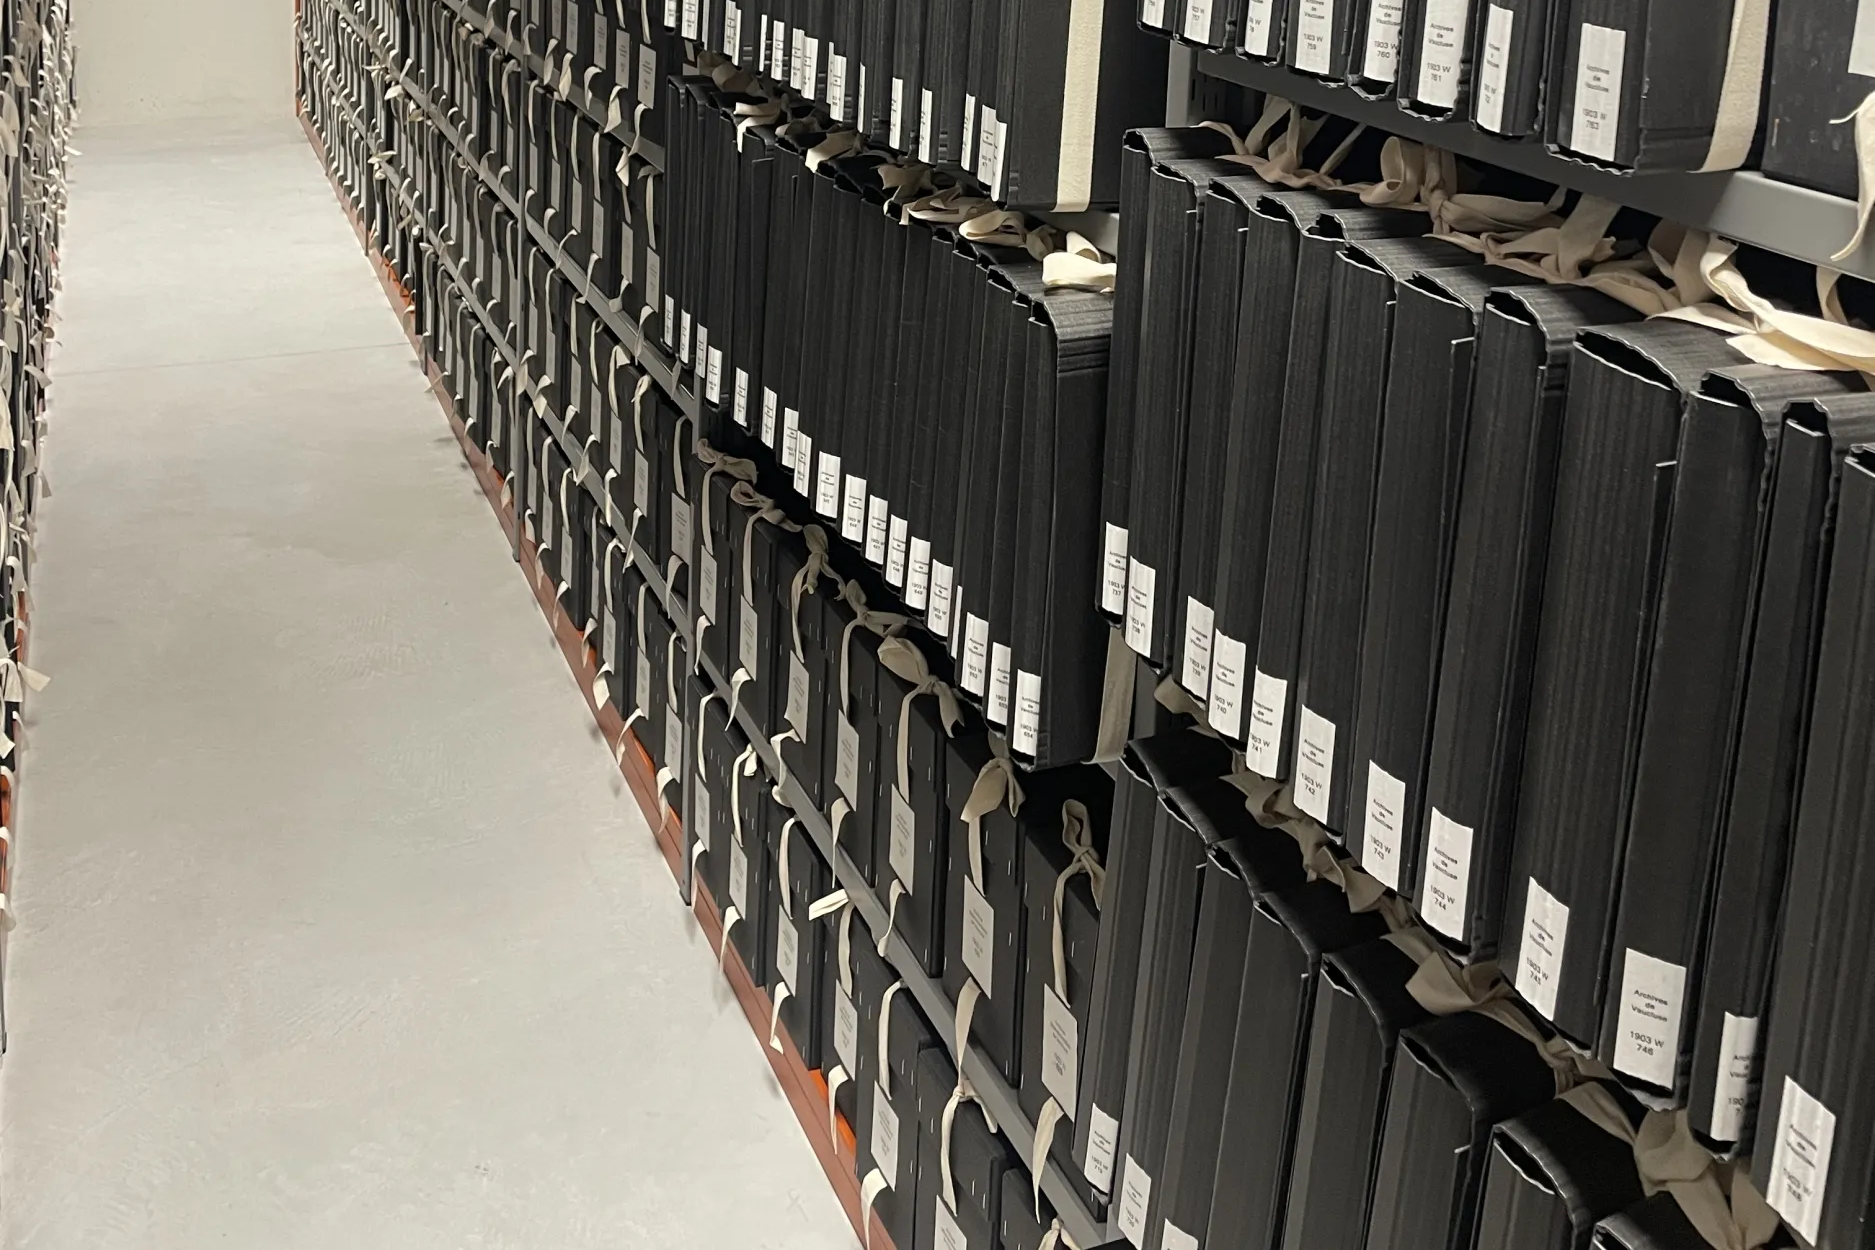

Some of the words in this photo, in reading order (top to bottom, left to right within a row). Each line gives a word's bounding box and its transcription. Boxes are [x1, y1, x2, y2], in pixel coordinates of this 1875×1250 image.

[1634, 989, 1668, 1006] Archives
[1644, 1002, 1655, 1010] de
[1631, 1003, 1668, 1022] Vaucluse
[1630, 1030, 1652, 1045] 1903
[1654, 1038, 1665, 1049] W
